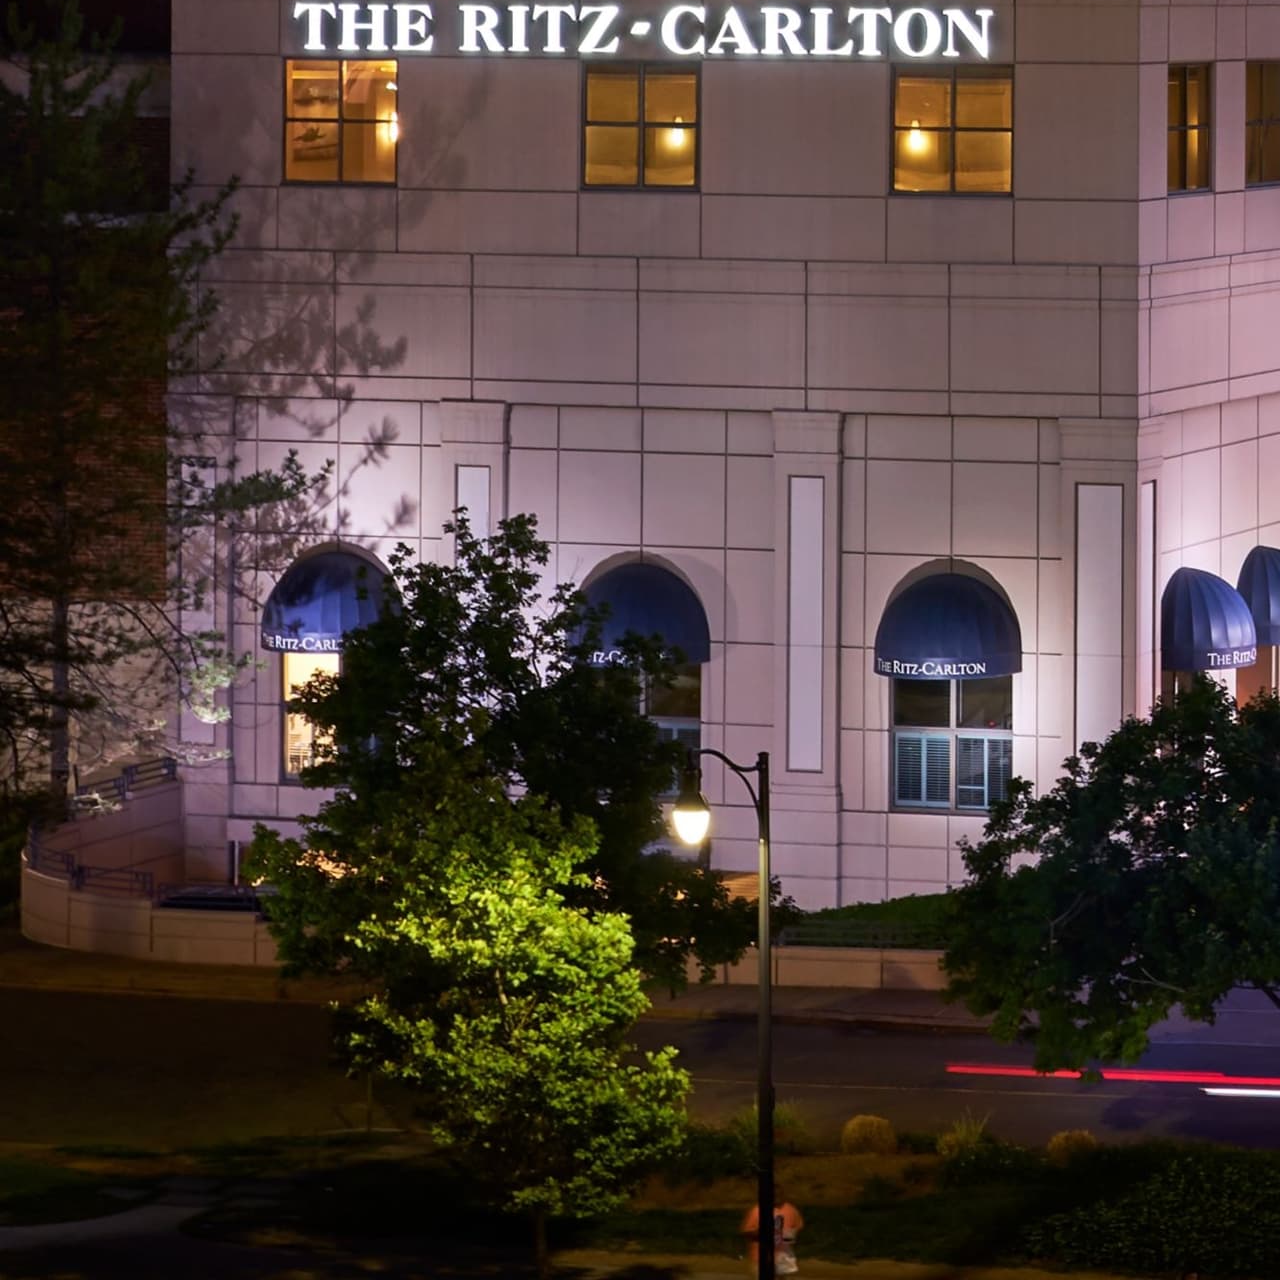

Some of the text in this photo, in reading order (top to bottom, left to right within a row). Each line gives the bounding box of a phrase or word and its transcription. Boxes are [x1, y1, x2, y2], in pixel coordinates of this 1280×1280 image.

[293, 1, 995, 60] THE RITZ-CARLTON
[893, 659, 986, 676] RITZ-CARLTON
